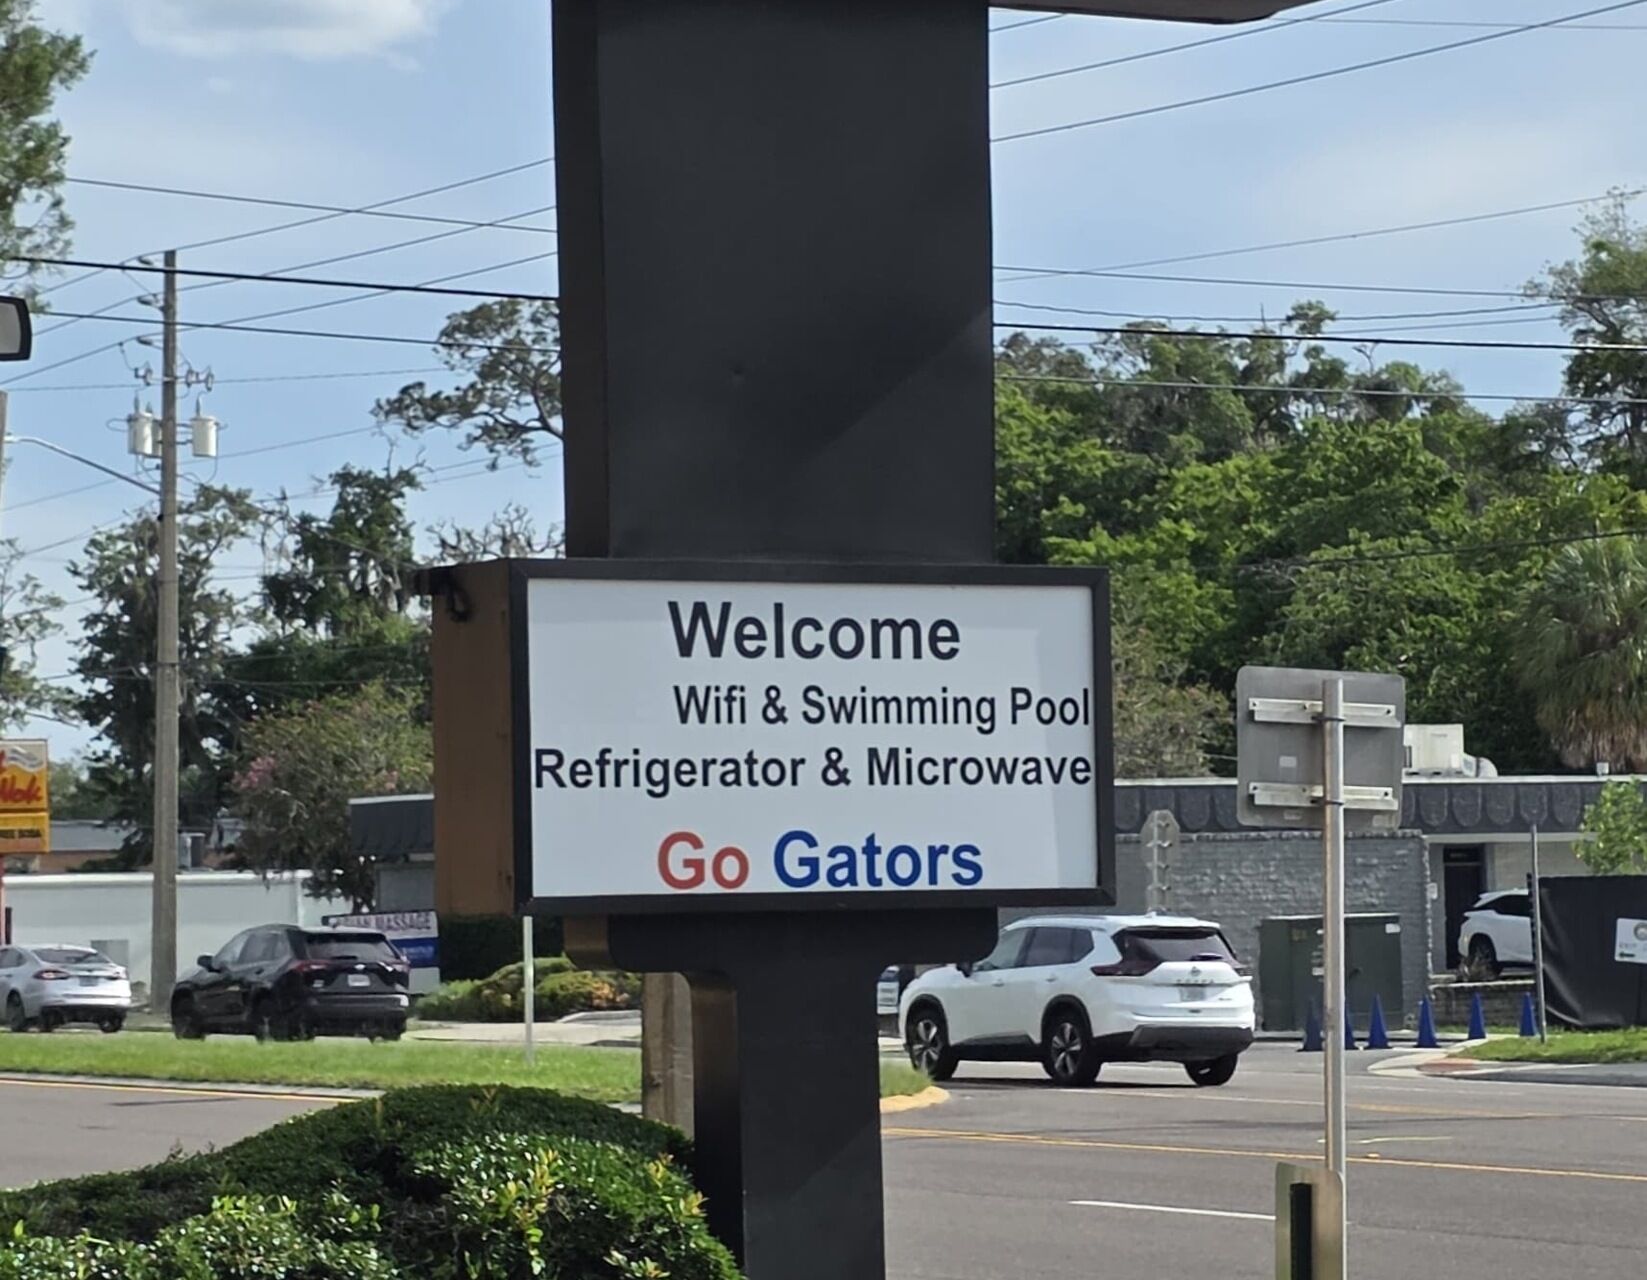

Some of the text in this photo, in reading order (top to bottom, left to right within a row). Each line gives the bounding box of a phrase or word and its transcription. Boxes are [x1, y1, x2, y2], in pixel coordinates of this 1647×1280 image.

[667, 600, 961, 660] Welcome
[672, 684, 1090, 736] Wifi & Swimming Pool
[533, 746, 1092, 799] Refrigerator & Microwave
[658, 829, 984, 890] Go Gators
